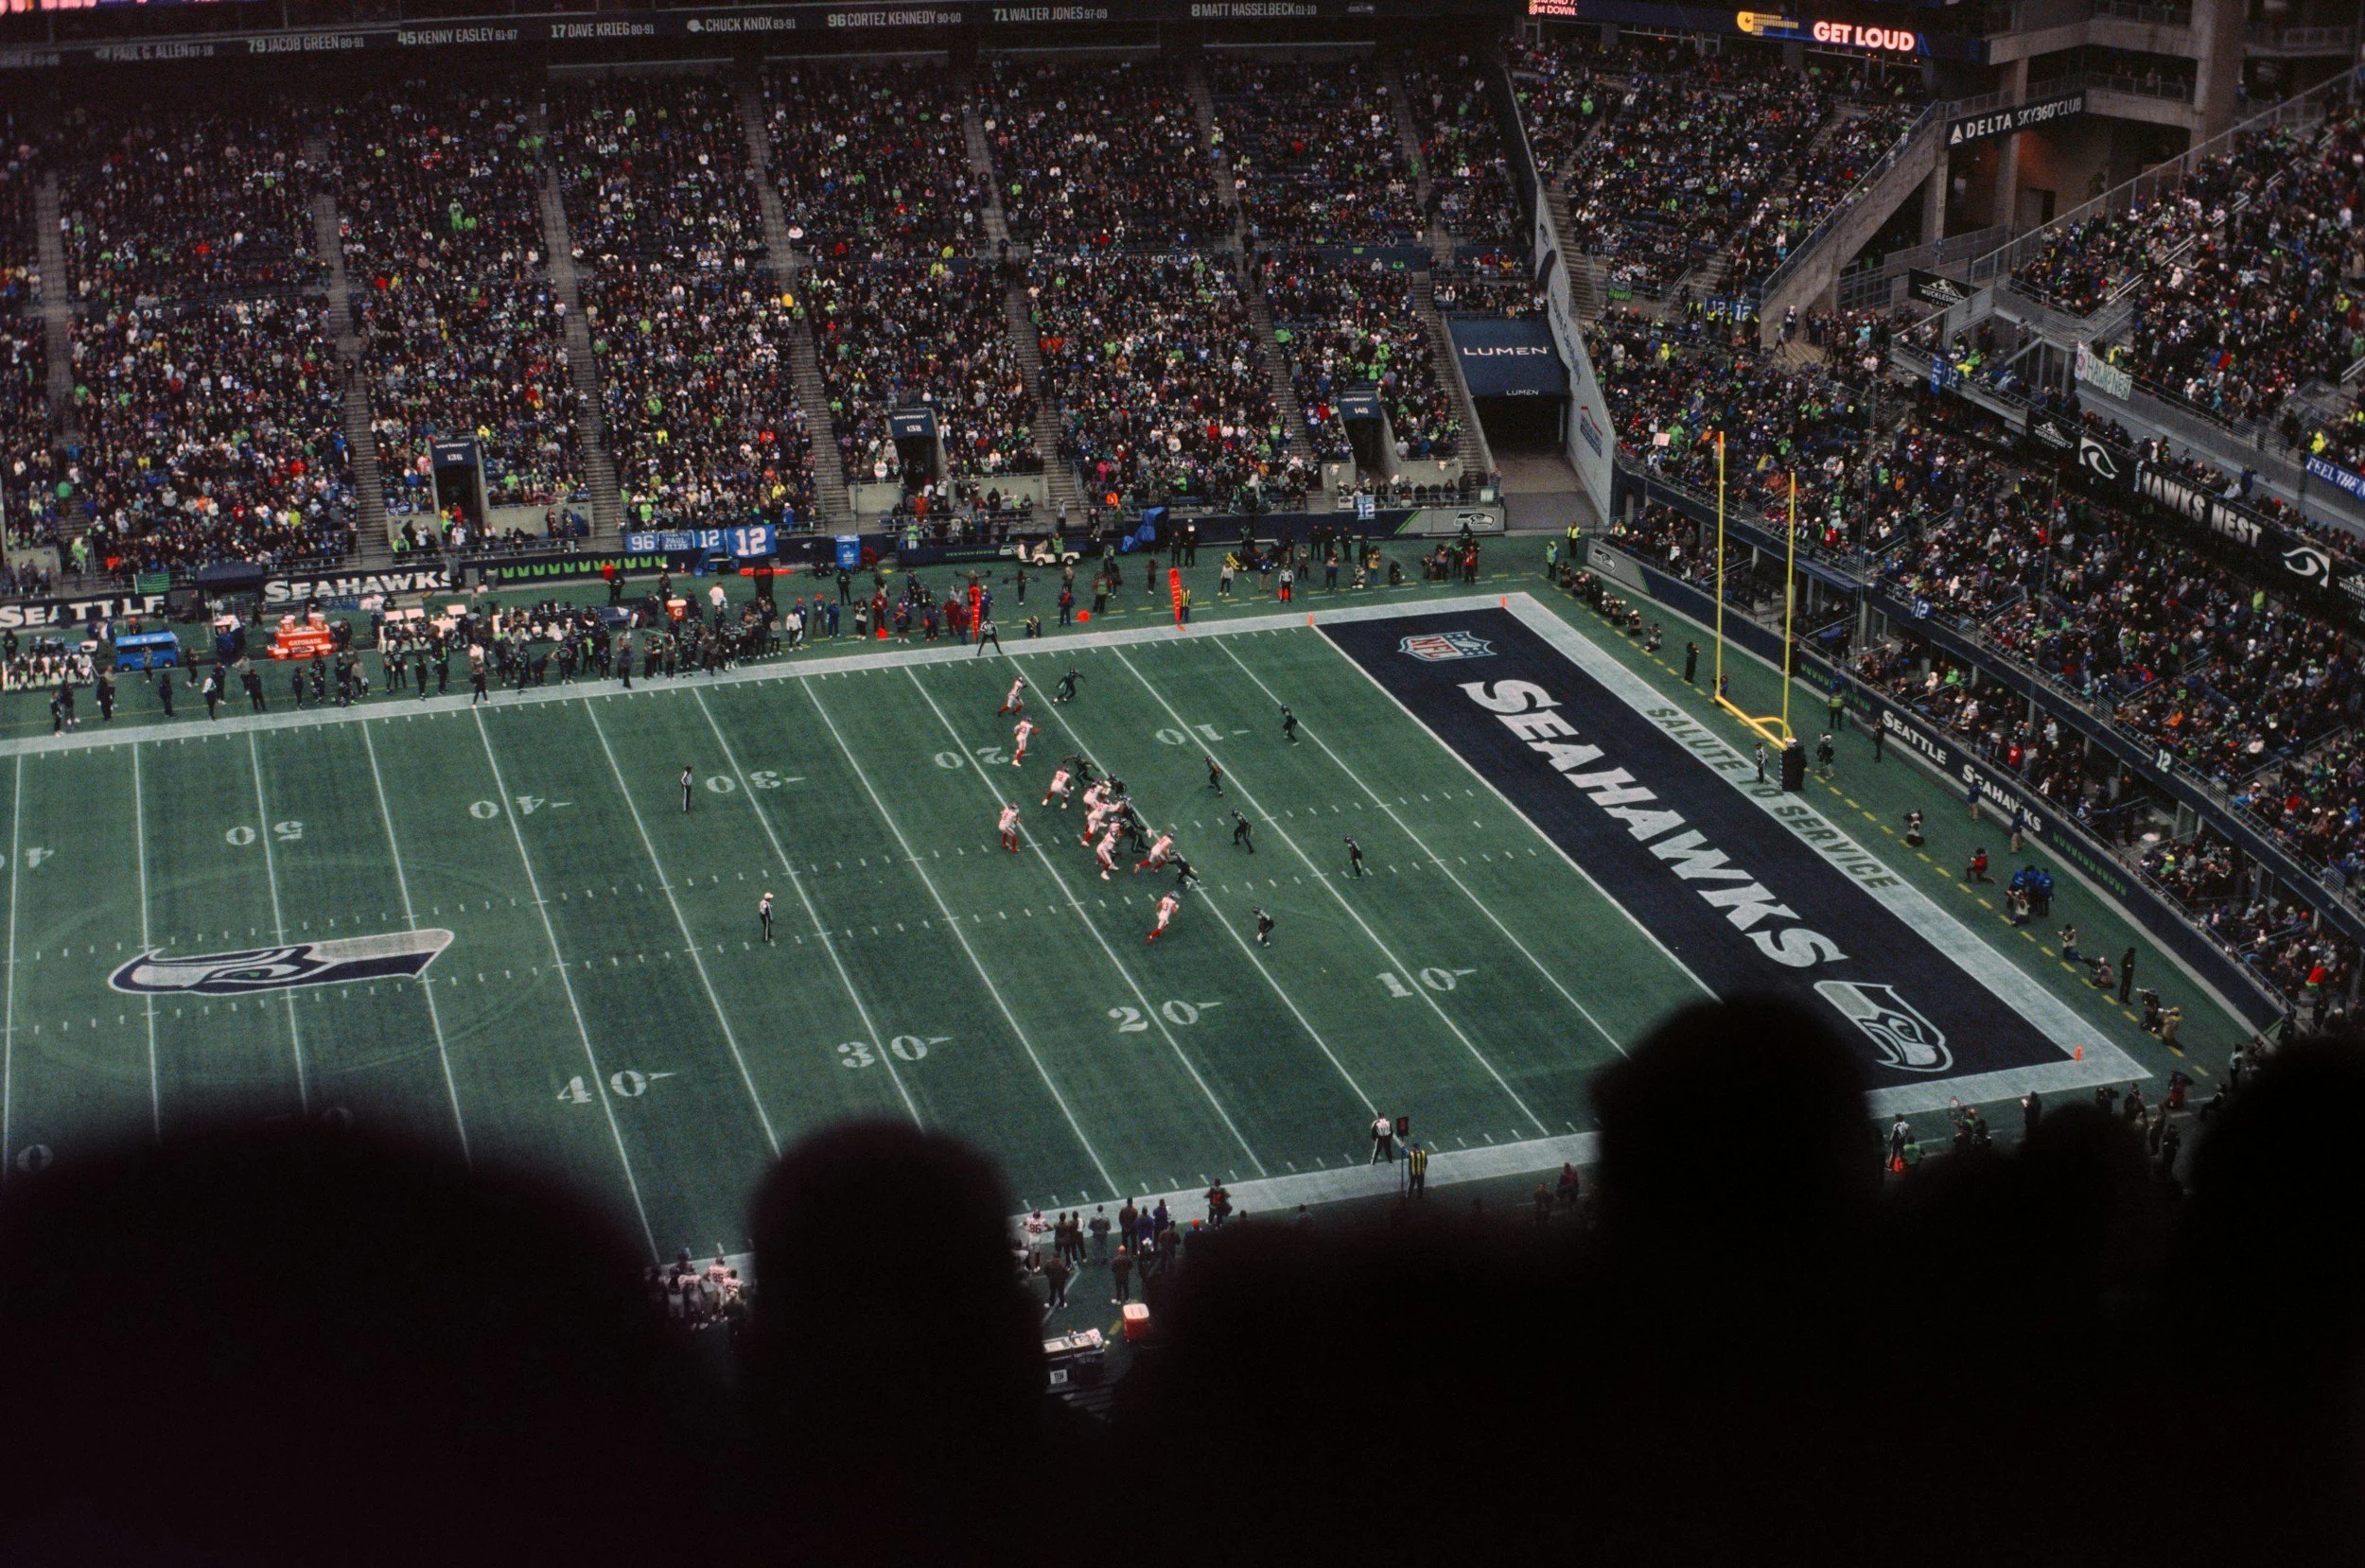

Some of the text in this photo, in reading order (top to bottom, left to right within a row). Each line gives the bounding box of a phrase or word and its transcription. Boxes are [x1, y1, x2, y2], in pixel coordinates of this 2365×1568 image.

[828, 13, 847, 26] 96
[847, 12, 886, 26] CORTEZ
[888, 10, 937, 26] KENNEDY
[993, 8, 1009, 22] 71
[1009, 8, 1049, 21] WALTER
[1051, 7, 1083, 20] JONES
[1191, 3, 1200, 16] 8
[1201, 3, 1229, 16] MATT
[1232, 2, 1295, 16] HASSELBECK
[397, 30, 416, 45] 45
[417, 29, 453, 44] KENNY
[456, 26, 494, 43] EASLEY
[551, 24, 567, 39] 17
[568, 24, 594, 38] DAVE
[596, 22, 630, 37] KRIEG
[706, 18, 742, 33] CHUCK
[744, 16, 773, 31] KNOX
[1813, 20, 1851, 44] GET
[1855, 26, 1915, 52] LOUD
[113, 46, 140, 61] PAUL
[155, 44, 189, 59] ALLEN
[247, 38, 266, 53] 79
[266, 38, 301, 53] JACOB
[304, 35, 339, 51] GREEN
[1966, 113, 2012, 139] DELTA
[1735, 304, 1752, 322] 12
[1463, 345, 1549, 357] LUMEN
[2306, 457, 2335, 481] FEEL
[2336, 469, 2360, 492] THE
[1358, 503, 1375, 518] 12
[2142, 469, 2205, 522] HAWKS
[2211, 502, 2262, 548] NEST
[631, 534, 655, 551] 96
[700, 530, 720, 549] 12
[735, 526, 766, 556] 12
[674, 607, 683, 617] G
[1915, 600, 1930, 619] 12
[1410, 636, 1463, 658] NFL
[1883, 710, 1947, 765] SEATTLE
[935, 746, 1009, 769] 20
[2156, 748, 2172, 774] 12
[706, 770, 780, 793] 30
[469, 795, 545, 820] 40
[1646, 707, 1749, 772] SALUTE
[1773, 805, 1901, 889] SERVICE
[226, 820, 304, 846] 50
[1457, 679, 1851, 967] SEAHAWKS
[1373, 965, 1460, 1003] 10
[1108, 1000, 1200, 1033] 20
[837, 1035, 929, 1069] 30
[557, 1070, 649, 1104] 40
